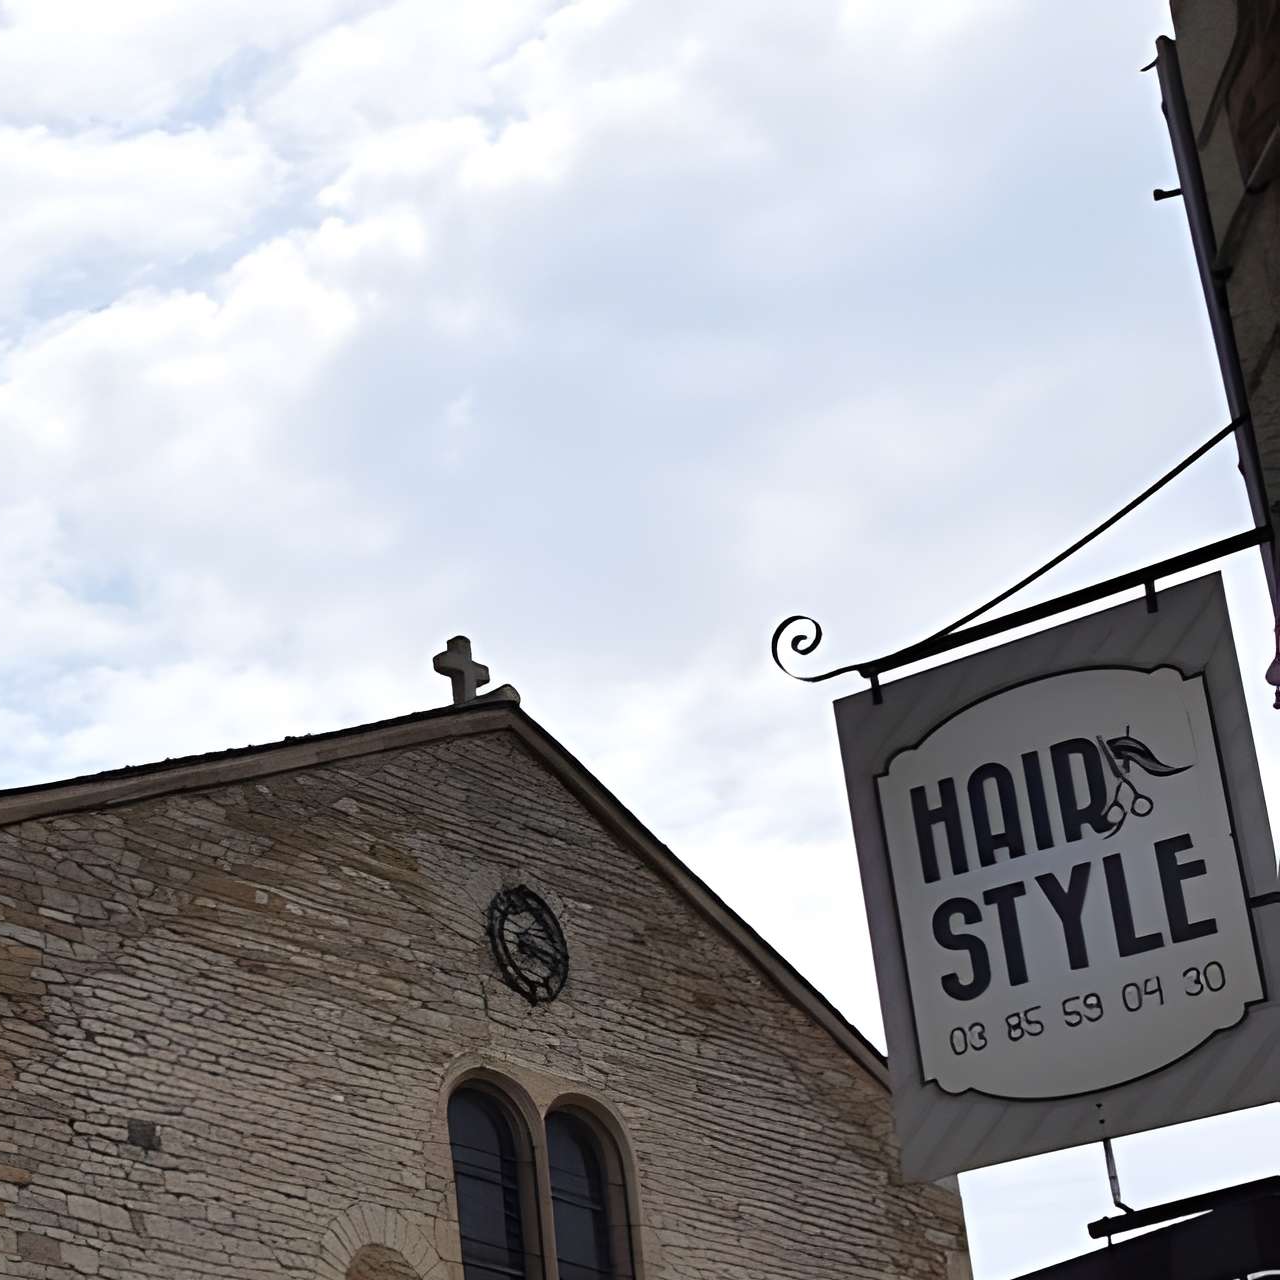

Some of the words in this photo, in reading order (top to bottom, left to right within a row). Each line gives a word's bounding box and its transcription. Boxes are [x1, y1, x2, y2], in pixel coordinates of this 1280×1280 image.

[909, 737, 1115, 884] HAIR
[931, 833, 1219, 1001] STYLE
[949, 1022, 988, 1056] 03
[1005, 1005, 1044, 1042] 85
[1062, 992, 1104, 1027] 59
[1122, 976, 1165, 1013] 04
[1182, 960, 1226, 998] 30
